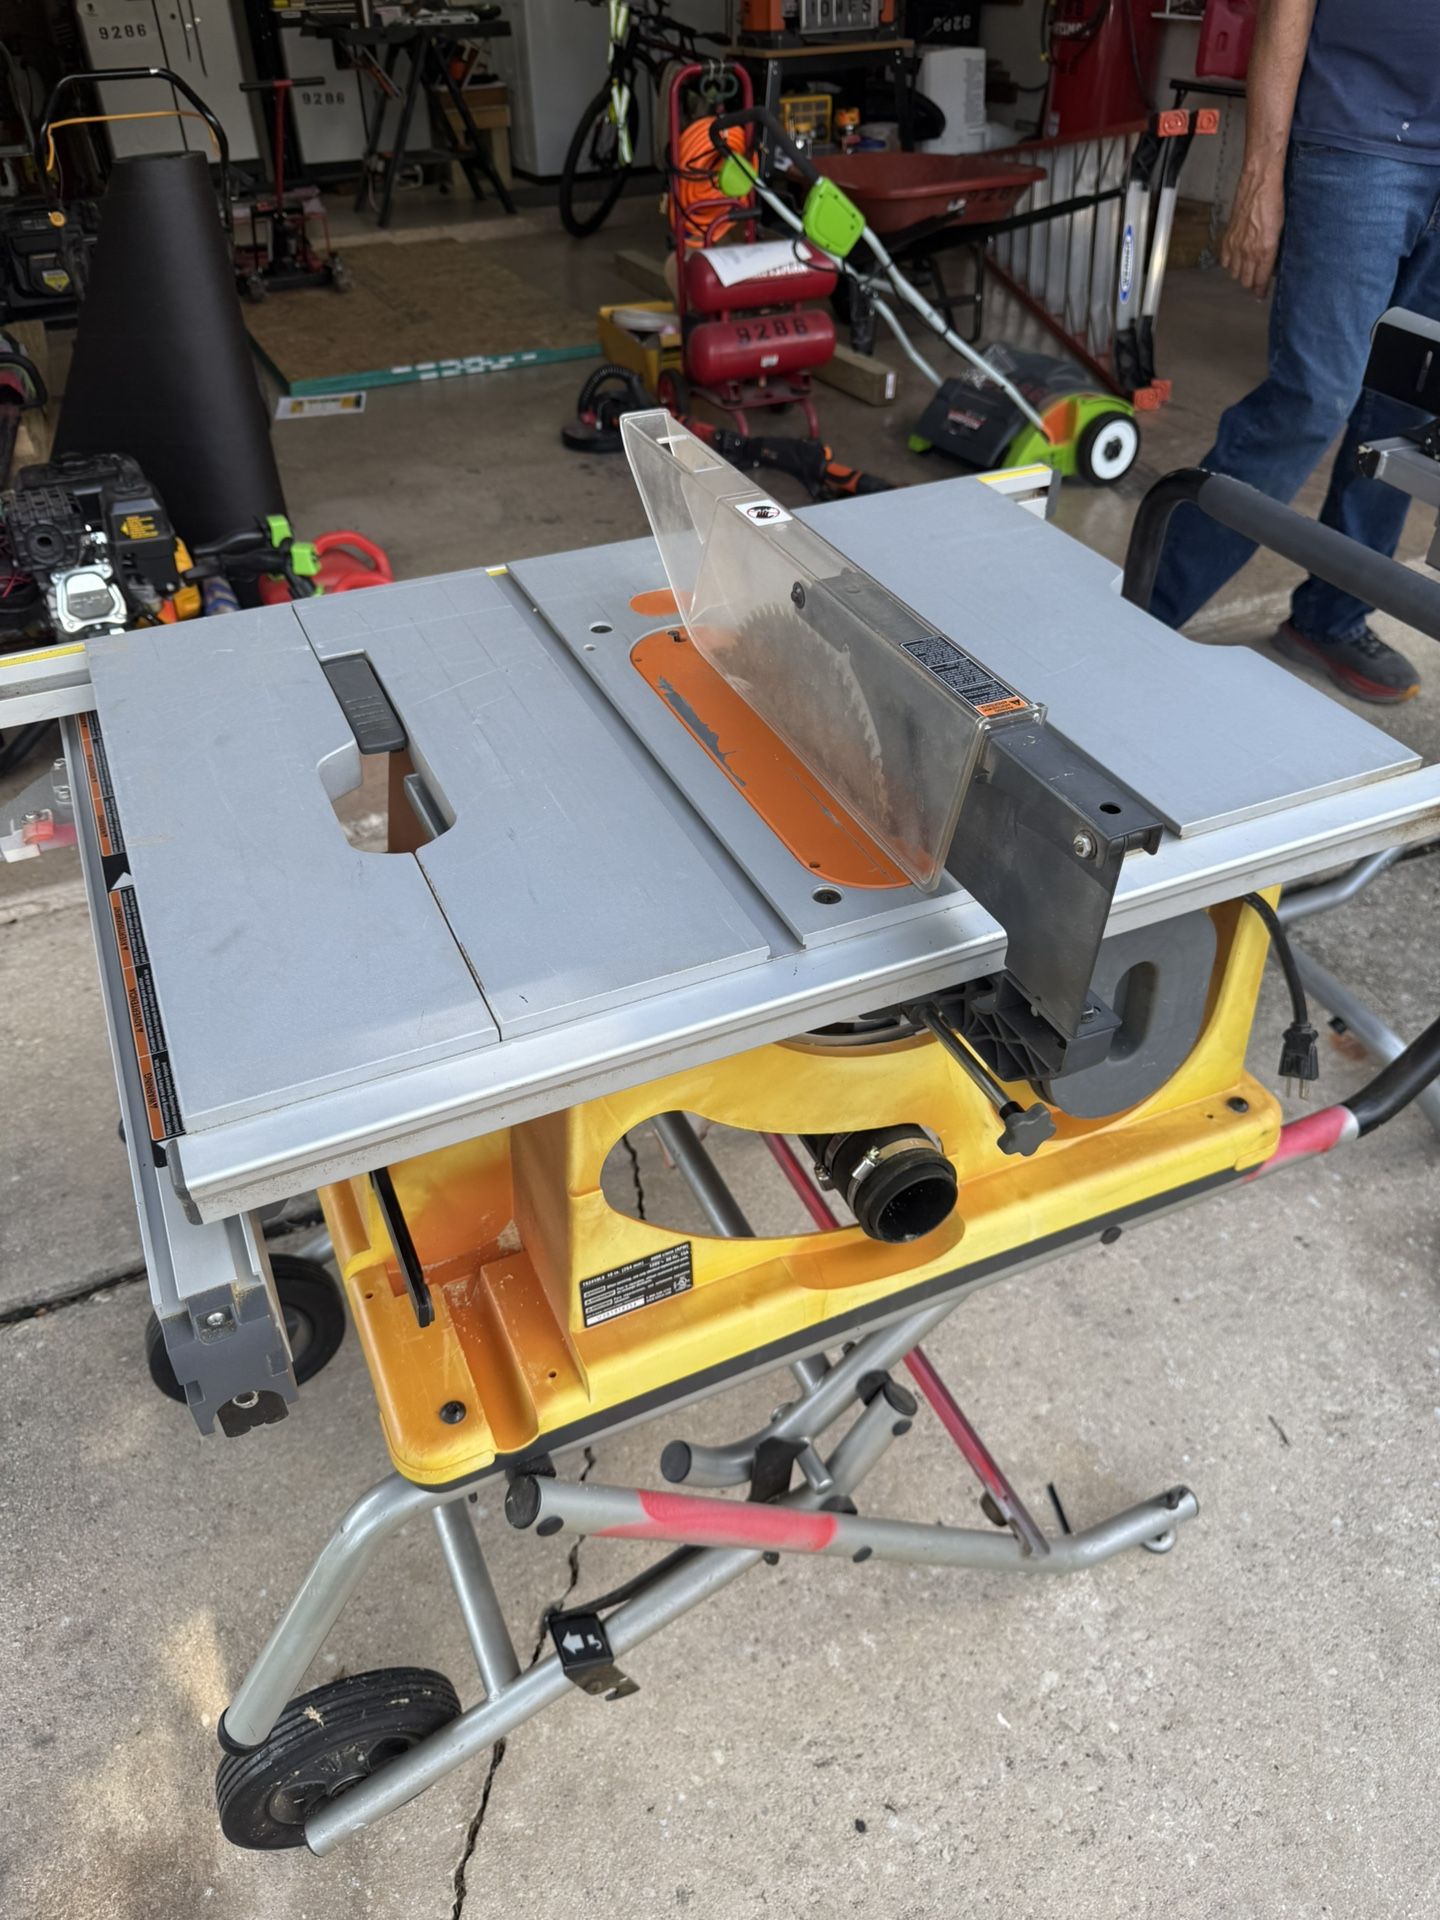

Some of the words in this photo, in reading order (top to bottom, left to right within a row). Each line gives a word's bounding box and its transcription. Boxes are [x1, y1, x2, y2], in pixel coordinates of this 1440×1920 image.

[98, 23, 147, 40] 9286
[736, 319, 808, 346] 9286
[144, 1073, 157, 1103] WARNING
